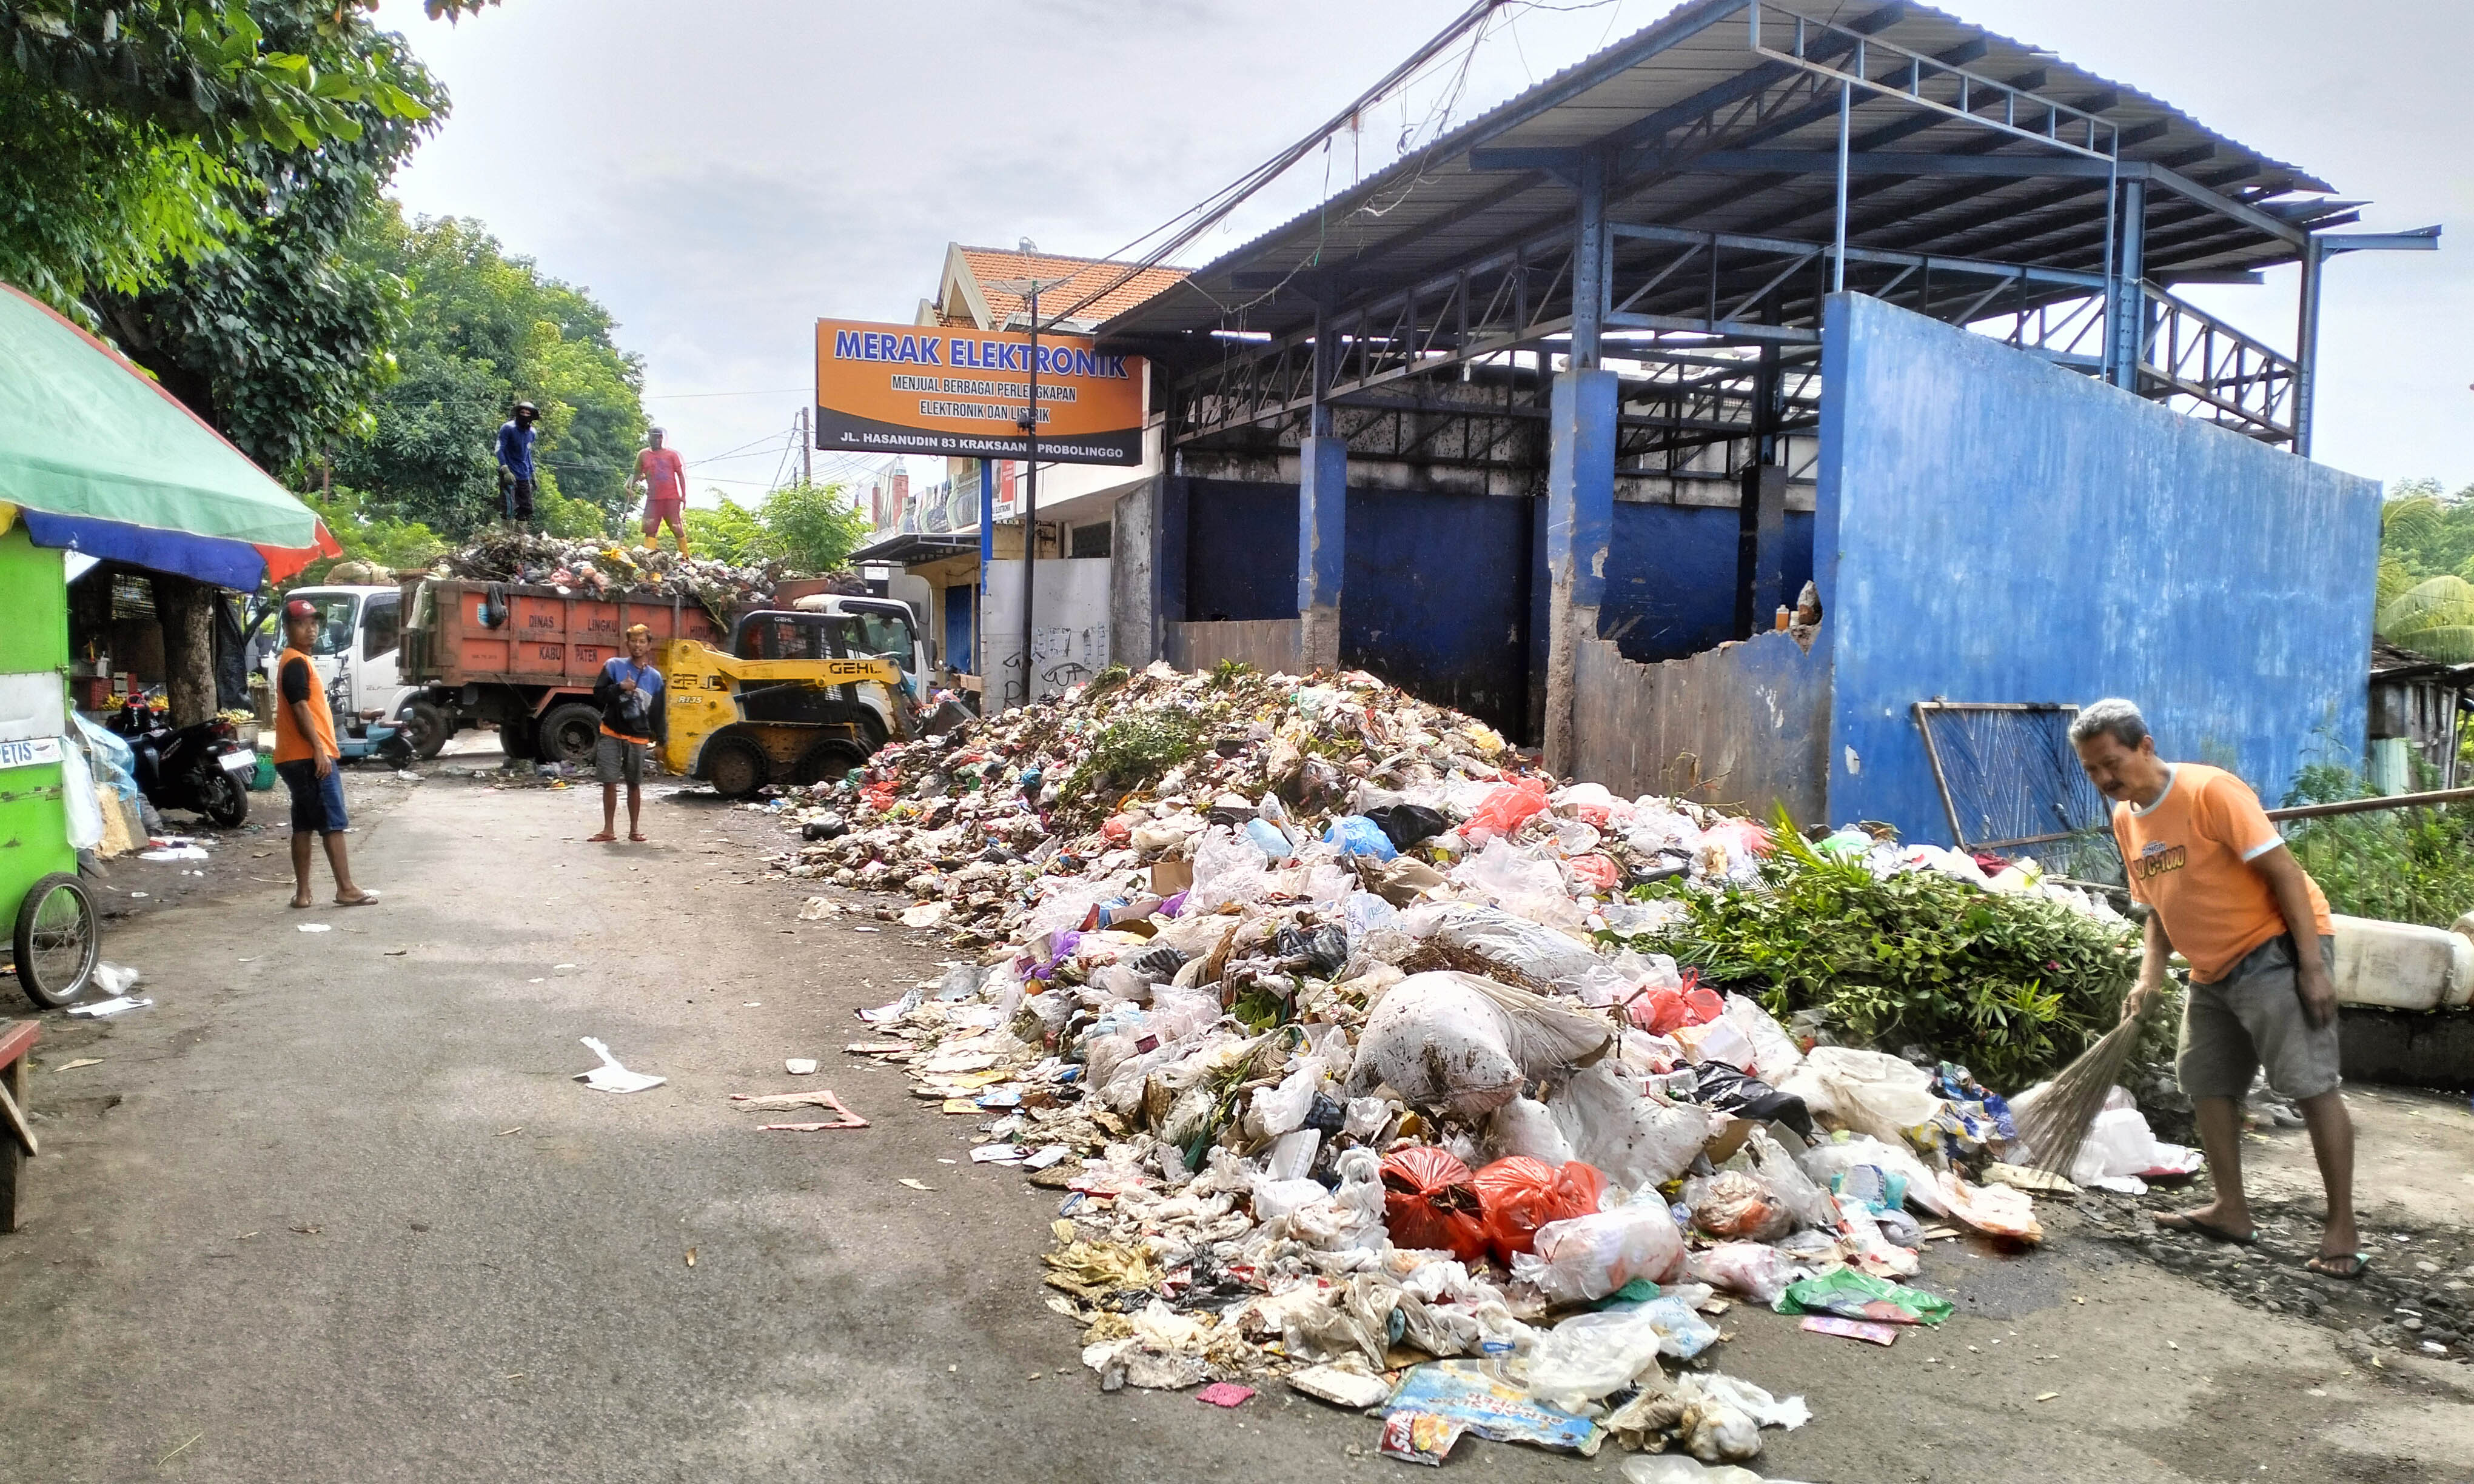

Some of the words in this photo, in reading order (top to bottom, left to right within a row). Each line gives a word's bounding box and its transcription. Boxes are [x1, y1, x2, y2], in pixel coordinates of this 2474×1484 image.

[835, 330, 941, 365] MERAK
[950, 339, 1128, 378] ELEKTRONIK
[893, 376, 939, 392] MENJUAL
[944, 379, 994, 395] BERBAGAI
[998, 383, 1076, 401] PERLEGKAPAN
[920, 401, 984, 418] ELEKTRONIK
[988, 406, 1007, 419] DAN
[840, 432, 859, 442] JL.
[863, 433, 937, 447] HASANUDIN
[941, 438, 956, 447] 83
[960, 439, 1027, 452] KRAKSAAN
[1038, 444, 1123, 457] PROBOLINGGO
[528, 615, 554, 629] DINAS
[588, 618, 617, 633] LINGKU
[830, 663, 879, 674] GEHL
[0, 742, 32, 765] ETIS
